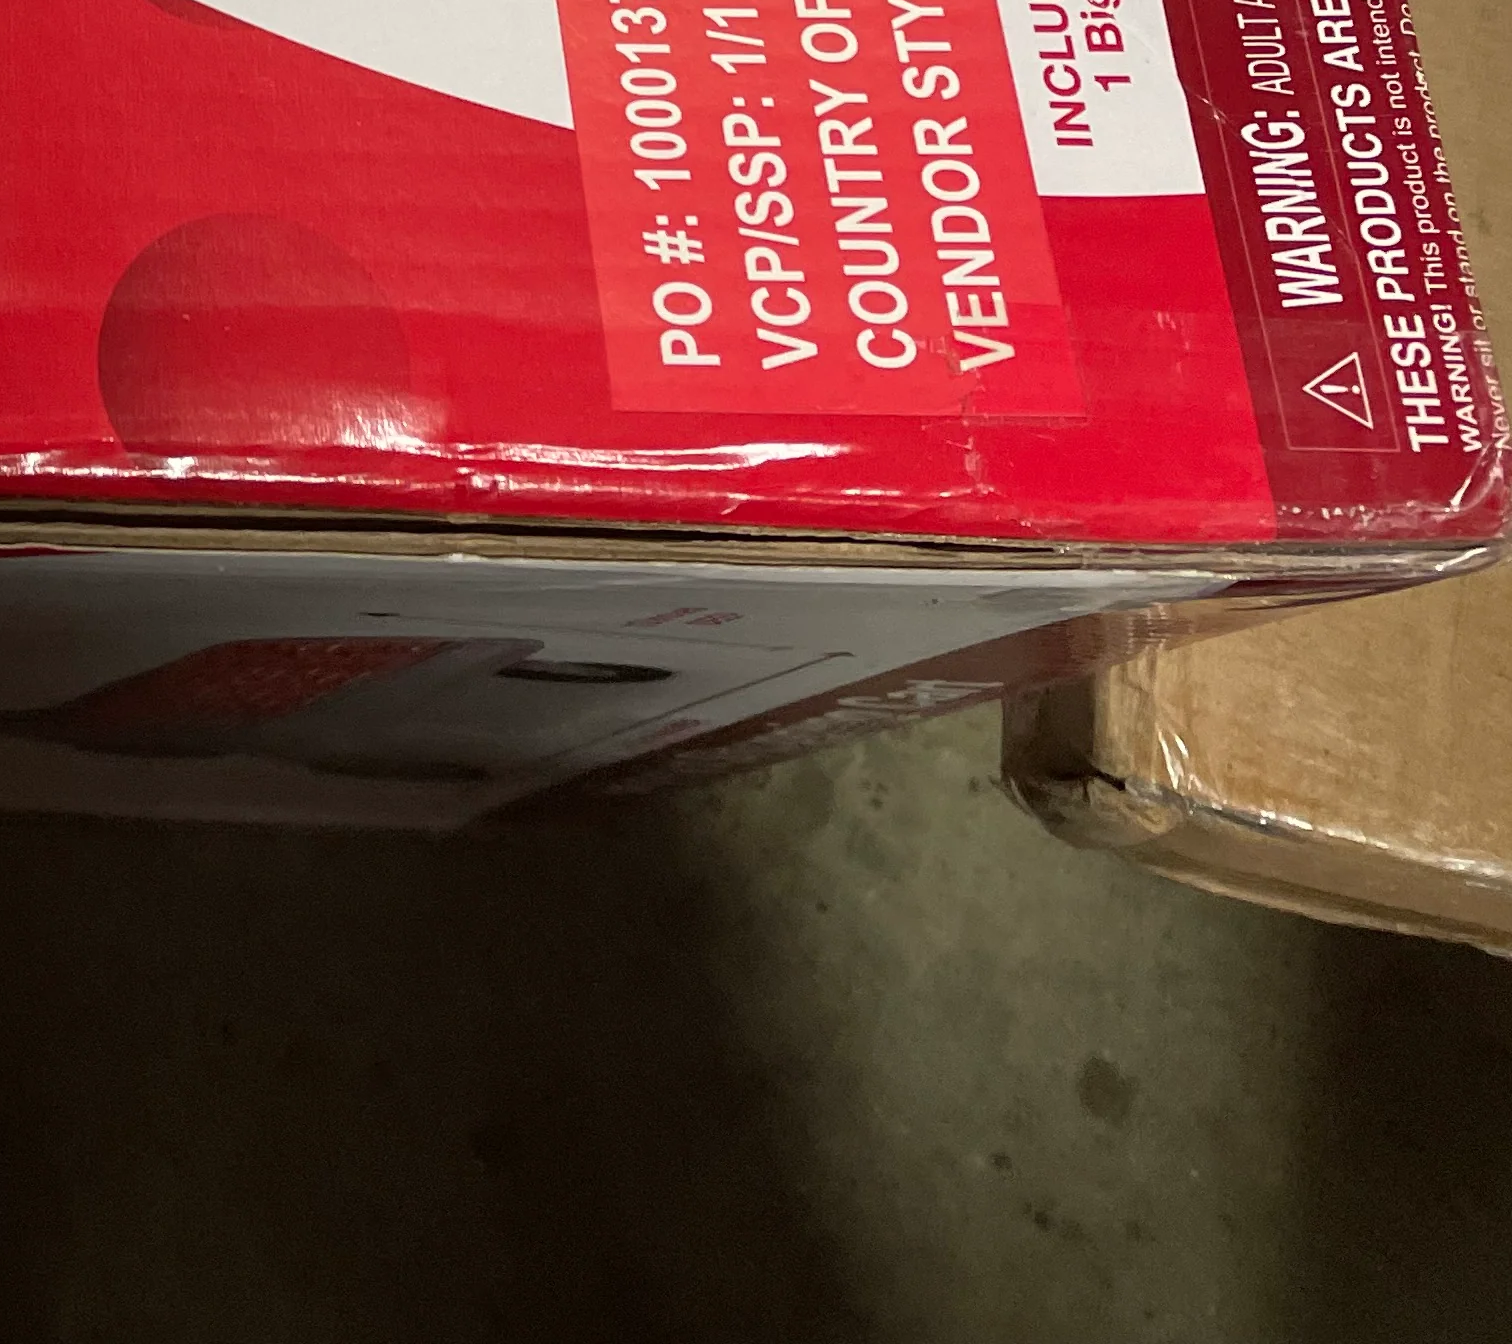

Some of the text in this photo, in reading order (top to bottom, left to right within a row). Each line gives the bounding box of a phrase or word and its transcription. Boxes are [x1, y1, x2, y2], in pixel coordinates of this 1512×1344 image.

[1093, 74, 1132, 93] 1
[1237, 8, 1295, 96] ADULT
[1385, 72, 1405, 109] not
[1392, 115, 1410, 137] is
[706, 6, 818, 370] VCP/SSP: 1/1
[818, 80, 917, 368] COUNTRY
[1241, 109, 1344, 308] WARNING:
[1335, 83, 1415, 301] PRODUCTS
[1398, 143, 1442, 234] product
[641, 214, 701, 263] #:
[915, 119, 1017, 372] VENDOR
[1420, 237, 1448, 293] This
[658, 281, 720, 367] PO
[1384, 313, 1448, 452] THESE
[1434, 303, 1482, 452] WARNING!
